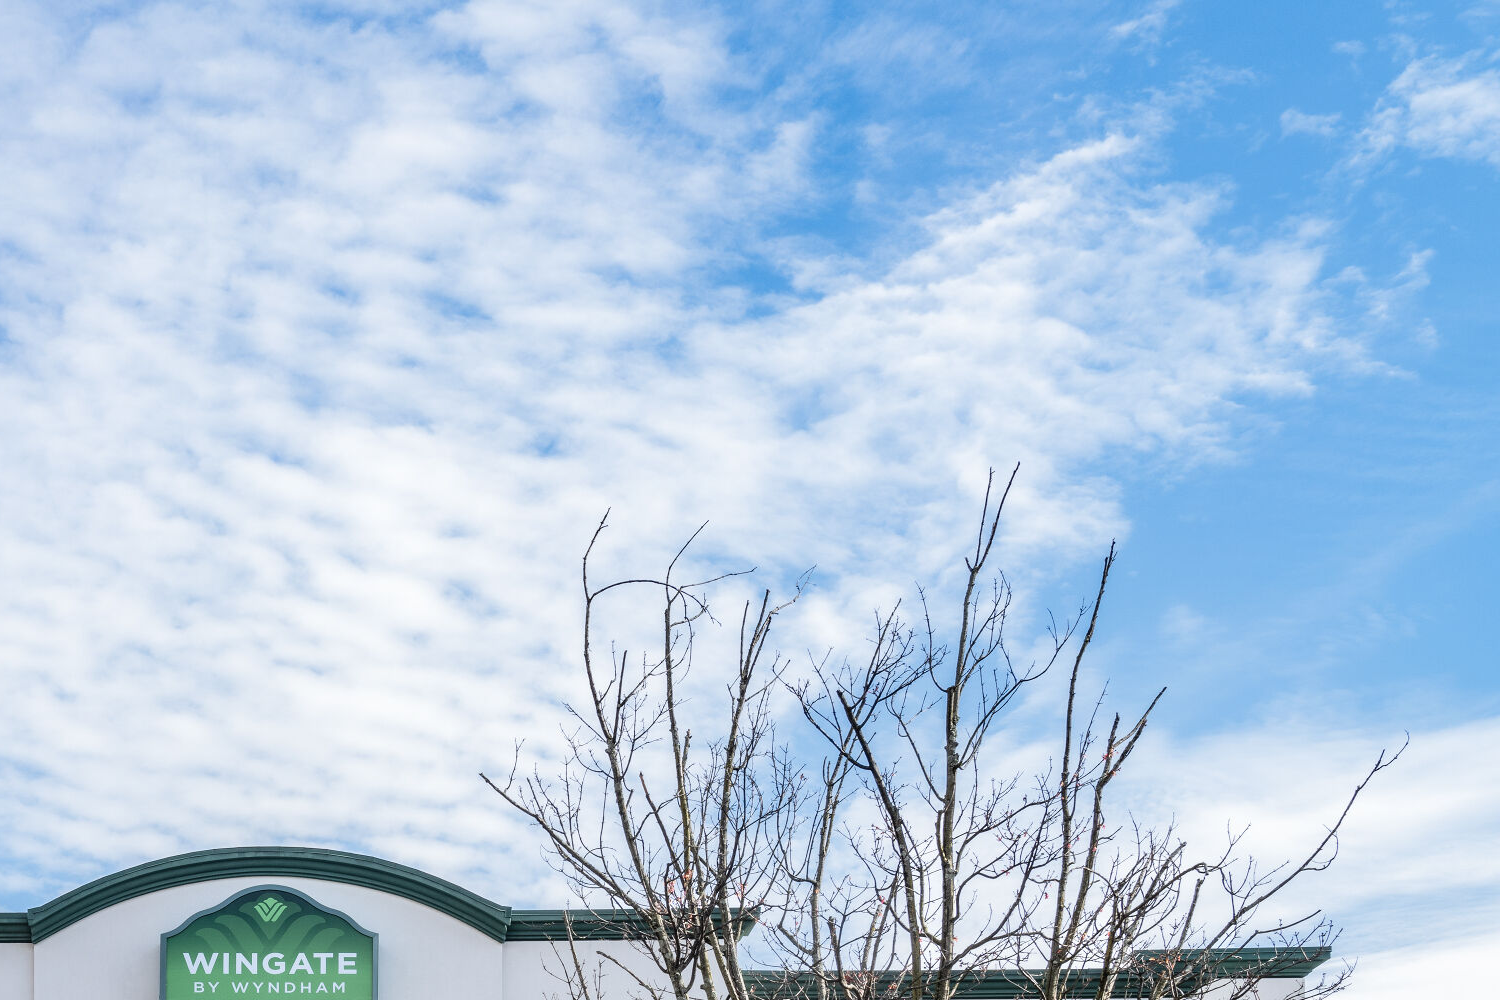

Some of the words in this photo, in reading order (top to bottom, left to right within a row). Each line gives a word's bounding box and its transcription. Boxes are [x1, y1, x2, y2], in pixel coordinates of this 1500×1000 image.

[183, 952, 358, 975] WINGATE
[193, 981, 220, 993] BY
[231, 981, 347, 993] WYNDHAM
